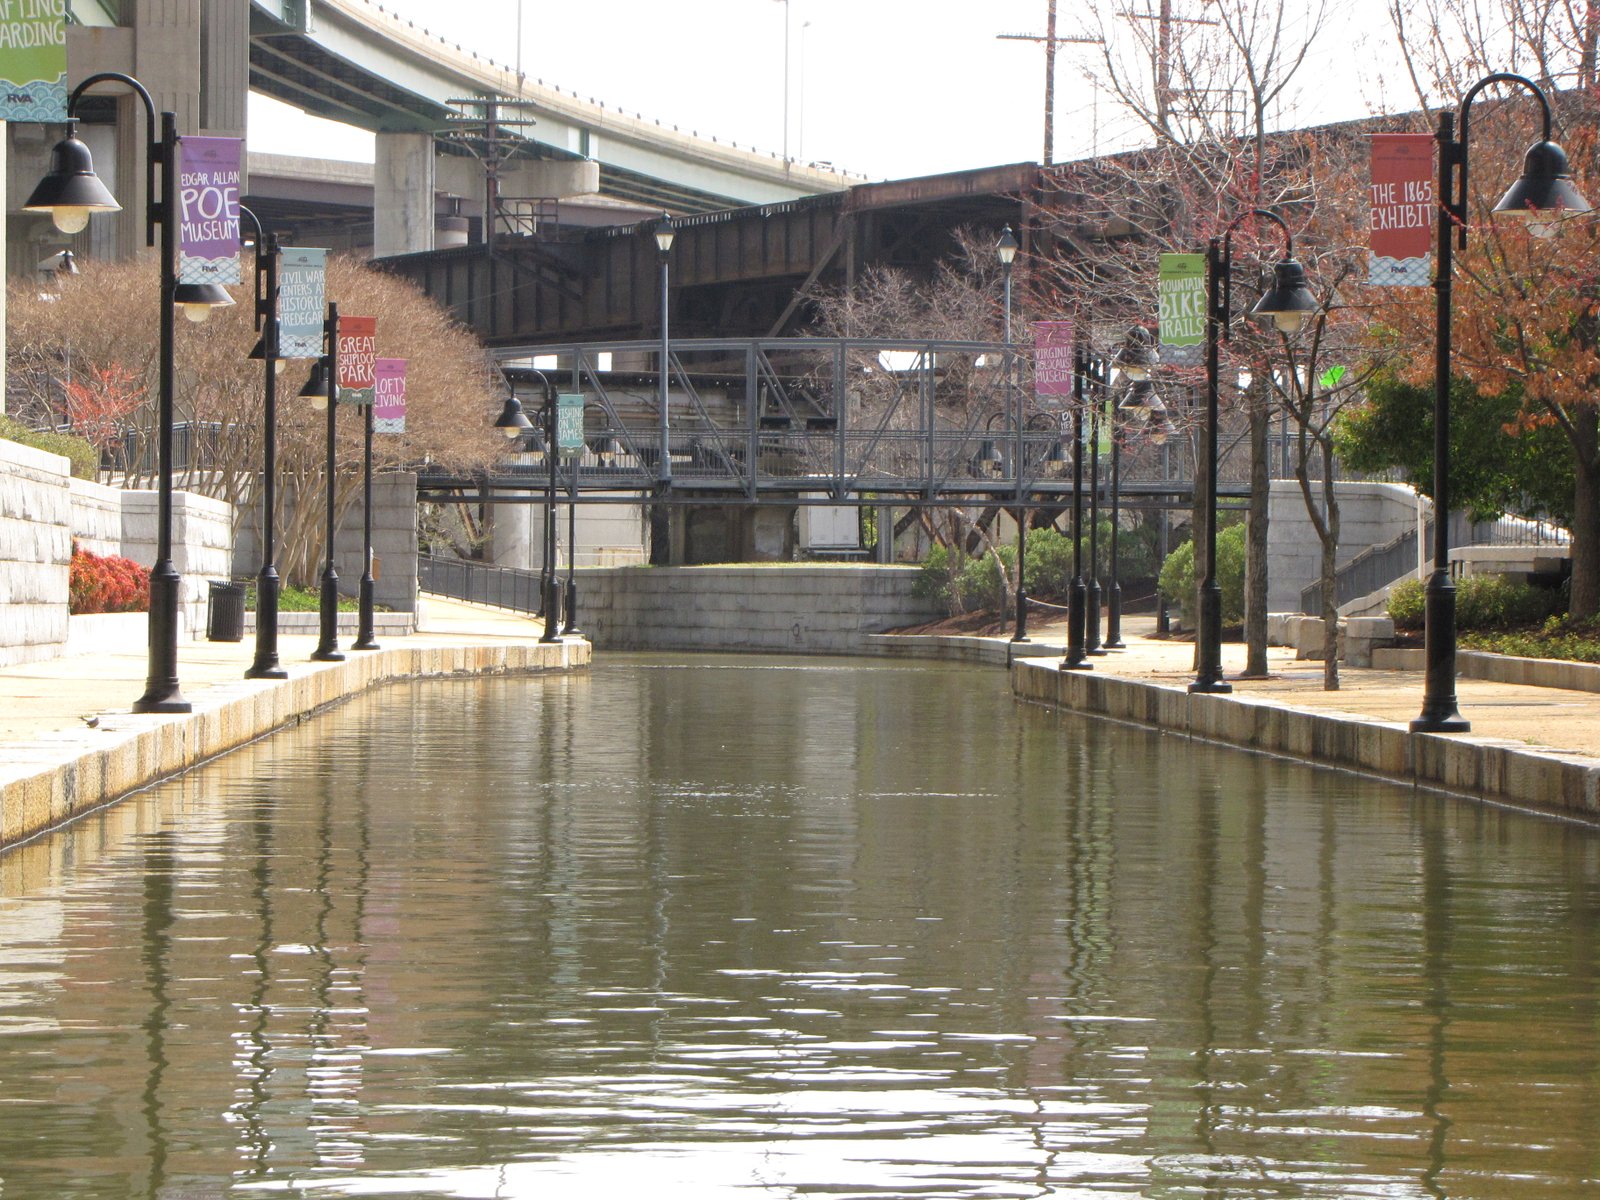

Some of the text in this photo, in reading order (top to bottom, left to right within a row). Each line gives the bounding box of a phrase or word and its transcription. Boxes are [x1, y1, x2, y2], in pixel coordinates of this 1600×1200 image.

[7, 93, 33, 104] RVA
[181, 170, 240, 187] EDGAR ALLAN
[1371, 181, 1432, 204] THE 1865
[180, 186, 240, 221] POE
[1370, 203, 1432, 230] EXHIBIT
[180, 218, 240, 243] MUSEUM
[280, 270, 325, 284] CIVIL WAR
[1160, 277, 1205, 293] MOUNTAIN
[280, 282, 325, 297] CENTERS AT
[280, 295, 325, 312] HISTORIC
[1159, 290, 1204, 320] BIKE
[280, 310, 324, 327] TREDEGAR
[1159, 316, 1205, 338] TRAILS
[340, 336, 375, 353] GREAT
[1035, 345, 1073, 359] VIRGINIA
[340, 352, 376, 366] SHIPLOCK
[340, 364, 376, 383] PARK
[375, 377, 406, 394] LOFTY
[375, 393, 406, 408] LIVING
[558, 428, 585, 442] JAMES
